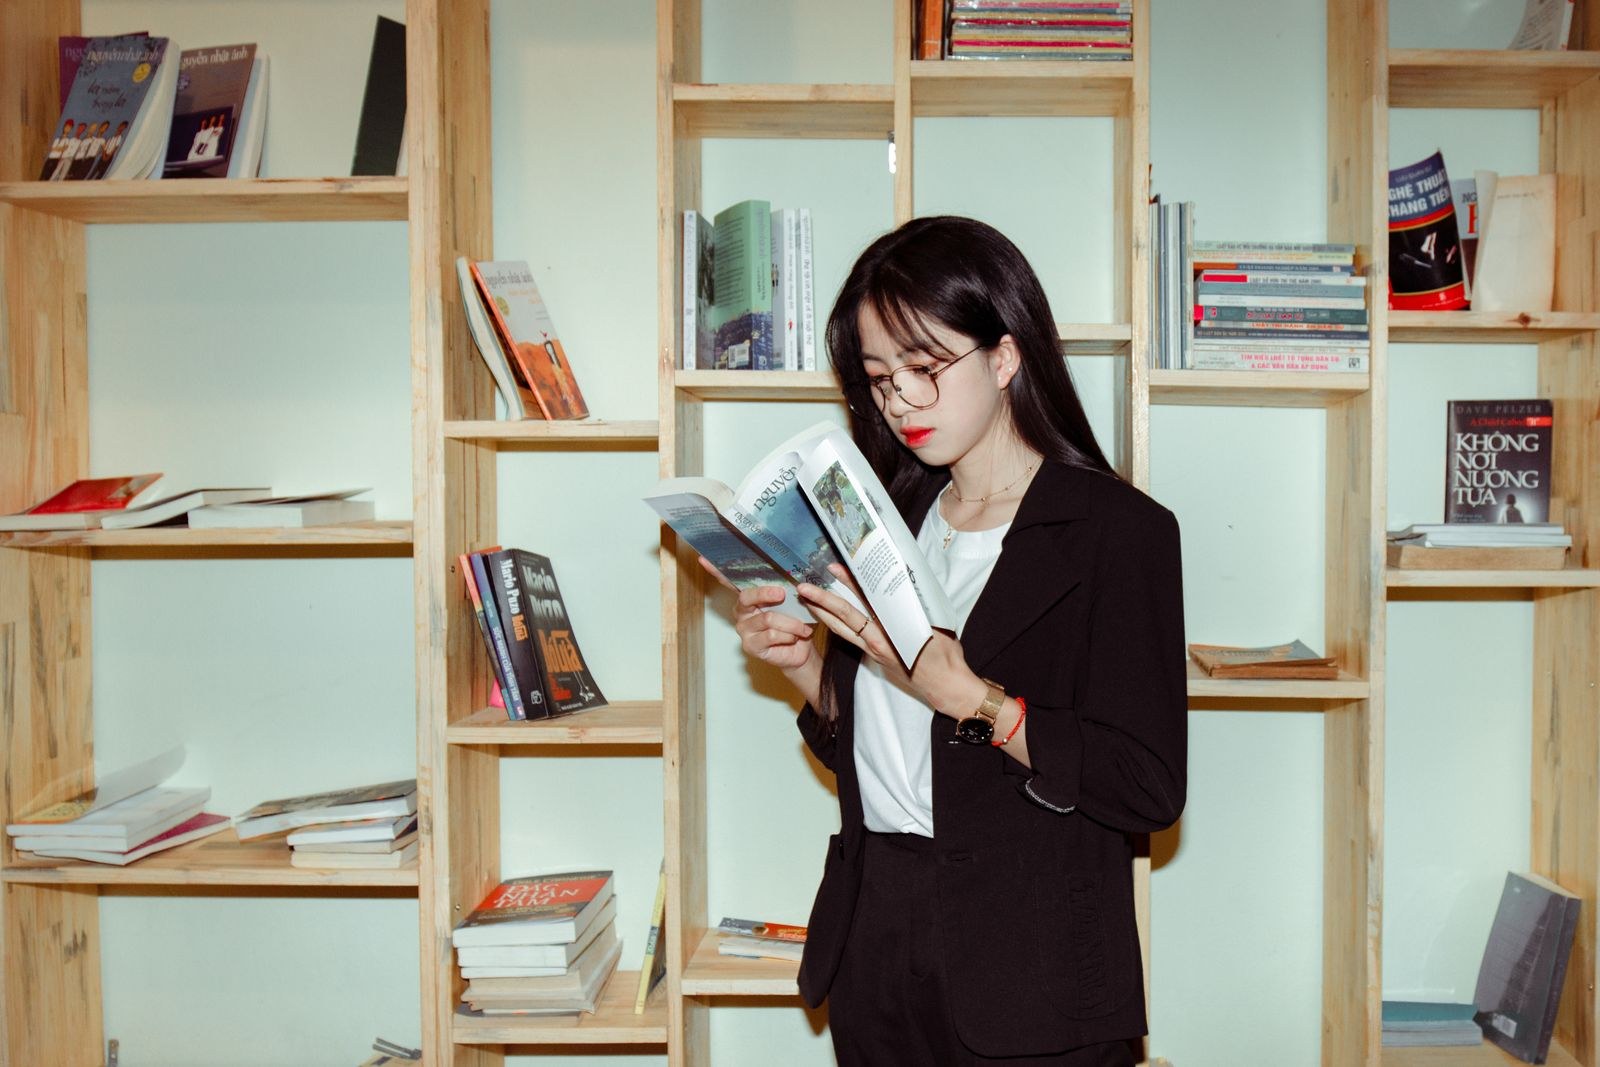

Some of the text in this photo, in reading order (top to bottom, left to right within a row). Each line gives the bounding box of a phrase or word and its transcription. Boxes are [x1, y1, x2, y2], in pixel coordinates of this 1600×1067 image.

[1388, 183, 1415, 202] GHỆ
[1456, 404, 1541, 414] DAVE PELZER
[1455, 430, 1540, 452] KHÔNG
[1454, 451, 1498, 470] NƠI
[1454, 470, 1539, 489] NƯƠNG
[1453, 487, 1499, 507] TỰA
[500, 558, 516, 588] Mario
[522, 565, 556, 592] Mario
[507, 588, 520, 614] Puzo
